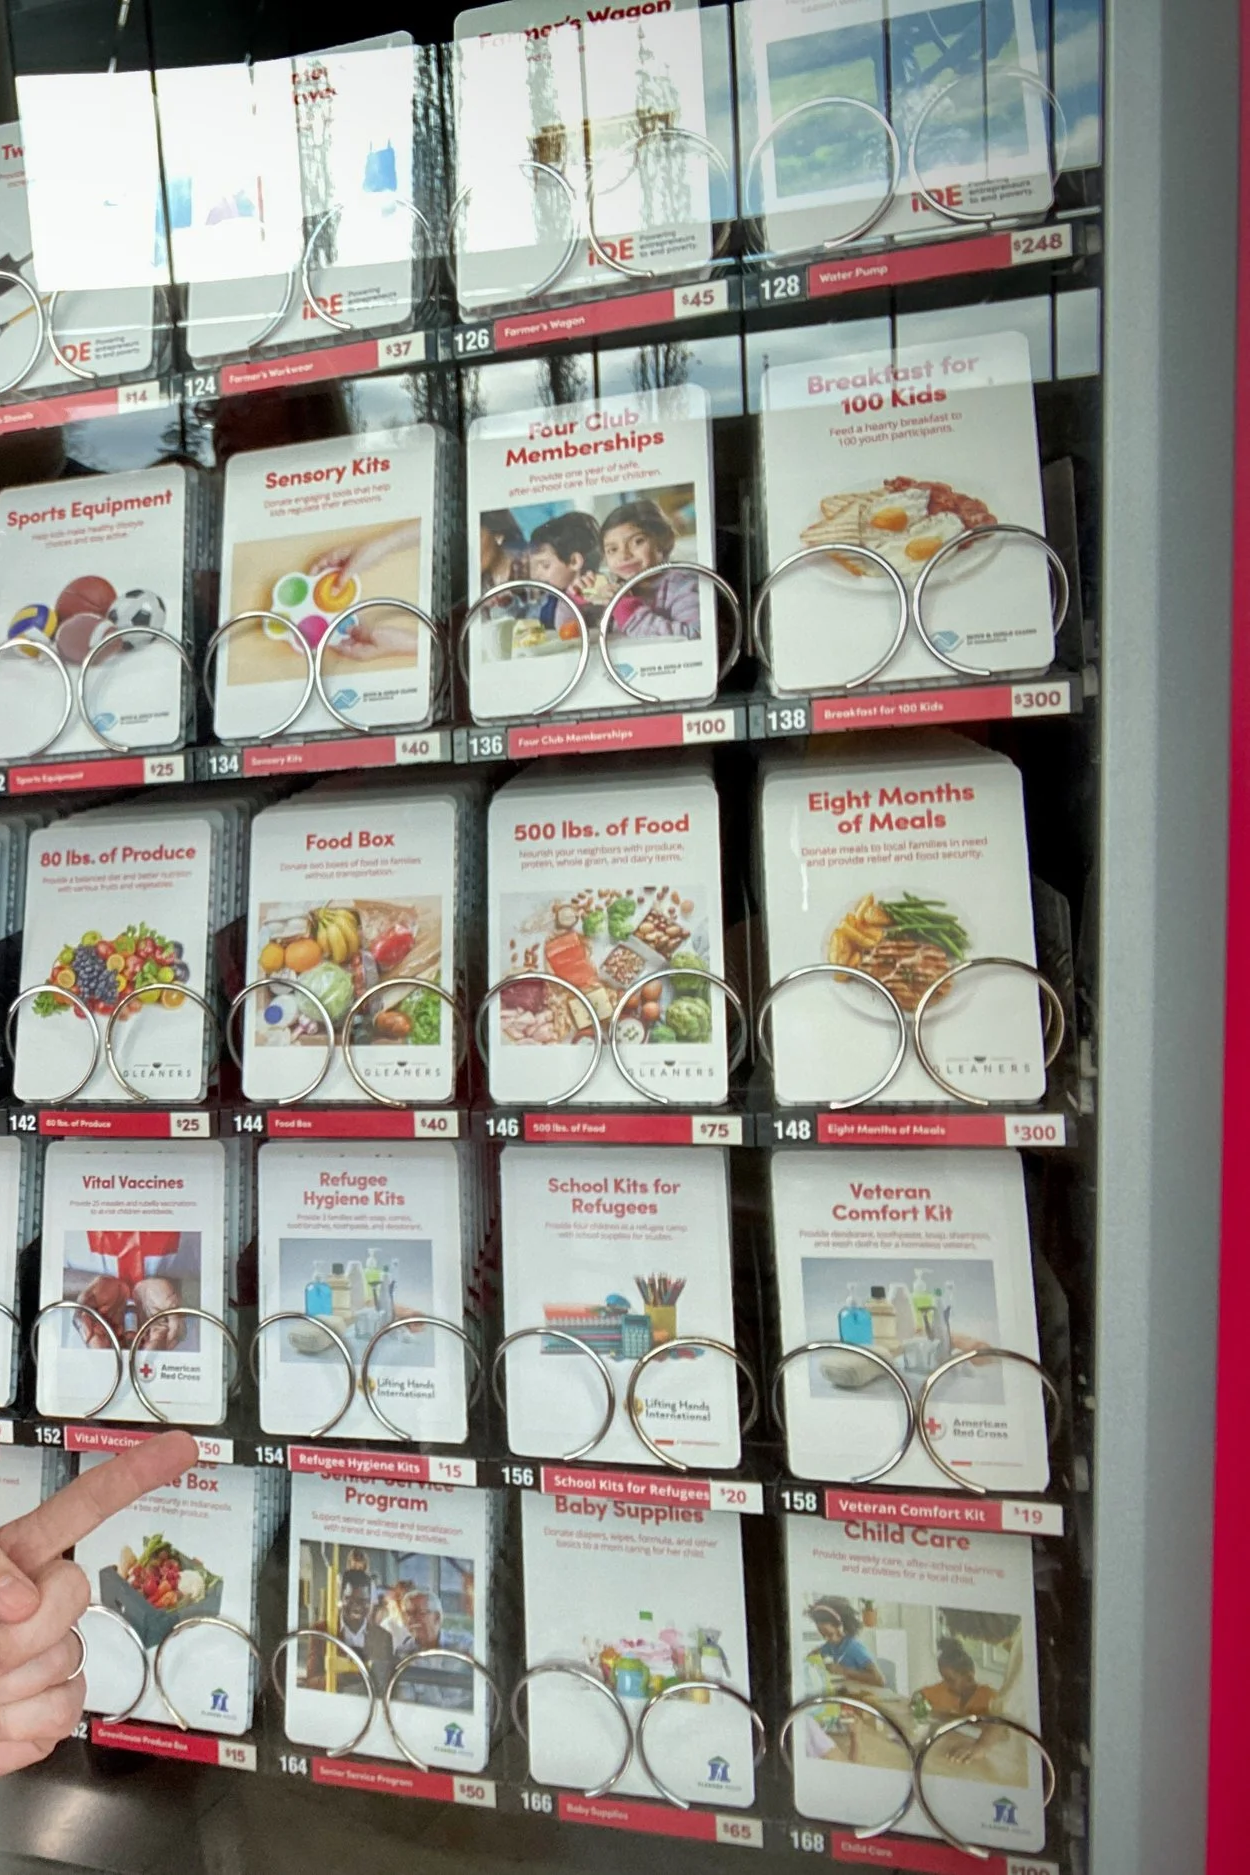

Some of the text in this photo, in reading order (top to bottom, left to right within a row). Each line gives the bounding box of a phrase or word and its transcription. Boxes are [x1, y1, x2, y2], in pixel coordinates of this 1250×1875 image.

[587, 0, 671, 24] Wagon
[1011, 233, 1062, 257] $248
[819, 266, 887, 283] Water Pump
[761, 275, 799, 299] 128
[682, 289, 714, 307] $45
[504, 317, 585, 337] Farmer's Wagon
[386, 340, 411, 357] $37
[455, 329, 489, 352] 126
[229, 364, 313, 383] Farmer's Workwear
[808, 356, 978, 395] Breakfast for
[126, 390, 147, 403] $14
[186, 376, 215, 399] 124
[840, 385, 946, 414] 100 Kids
[529, 409, 639, 440] Four Club
[830, 426, 854, 437] Feed
[865, 421, 897, 432] hearty
[901, 413, 948, 427] breakfast
[838, 425, 954, 446] 100 youth participants.
[506, 431, 664, 467] Memberships
[266, 457, 390, 489] Sensory Kits
[8, 490, 172, 529] Sports Equipment
[1015, 691, 1060, 708] $300
[768, 709, 805, 730] 138
[824, 702, 943, 719] Breakfast for 100 Kids
[687, 719, 725, 735] $100
[470, 736, 502, 755] 136
[519, 730, 633, 746] Four Club Memberships
[402, 741, 429, 755] $40
[151, 761, 176, 776] $25
[210, 755, 238, 773] 134
[809, 784, 974, 815] Eight Months
[515, 814, 689, 841] 500 lbs. of Food
[838, 810, 946, 833] of Meals
[307, 831, 394, 850] Food Box
[41, 845, 195, 867] 80 lbs. of Produce
[10, 1115, 35, 1130] 142
[177, 1119, 199, 1131] $25
[235, 1115, 263, 1132] 144
[421, 1118, 447, 1131] $40
[487, 1118, 518, 1136] 146
[701, 1124, 729, 1138] $75
[774, 1120, 810, 1139] 148
[828, 1124, 945, 1136] Eight Months of Meals
[1014, 1126, 1056, 1141] $300
[83, 1175, 183, 1189] Vital Vaccines
[320, 1172, 387, 1191] Refugee
[549, 1178, 680, 1194] School Kits for
[304, 1190, 405, 1210] Hygiene Kits
[850, 1183, 930, 1200] Veteran
[572, 1198, 658, 1218] Refugees
[832, 1204, 952, 1221] Comfort Kit
[161, 1364, 200, 1376] American
[161, 1371, 200, 1381] Red Cross
[374, 1378, 434, 1393] Lifting Hands
[374, 1388, 435, 1400] International
[36, 1428, 60, 1443] 152
[74, 1433, 99, 1444] Vital
[197, 1441, 220, 1457] $50
[256, 1446, 283, 1467] 154
[299, 1453, 420, 1473] Refugee Hygiene Kits
[439, 1462, 462, 1478] $15
[187, 1473, 218, 1491] Box
[502, 1467, 533, 1486] 156
[554, 1475, 712, 1504] School Kits for Refugees
[721, 1488, 746, 1504] $20
[345, 1487, 428, 1512] Program
[782, 1491, 816, 1511] 158
[555, 1495, 704, 1525] Baby Supplies
[839, 1499, 984, 1521] Veteran Comfort Kit
[1014, 1507, 1042, 1524] $19
[844, 1520, 970, 1550] Child Care
[226, 1748, 245, 1763] $15
[280, 1756, 307, 1774] 164
[460, 1784, 485, 1800] $50
[522, 1792, 552, 1812] 166
[723, 1823, 751, 1840] $65
[791, 1830, 824, 1852] 168
